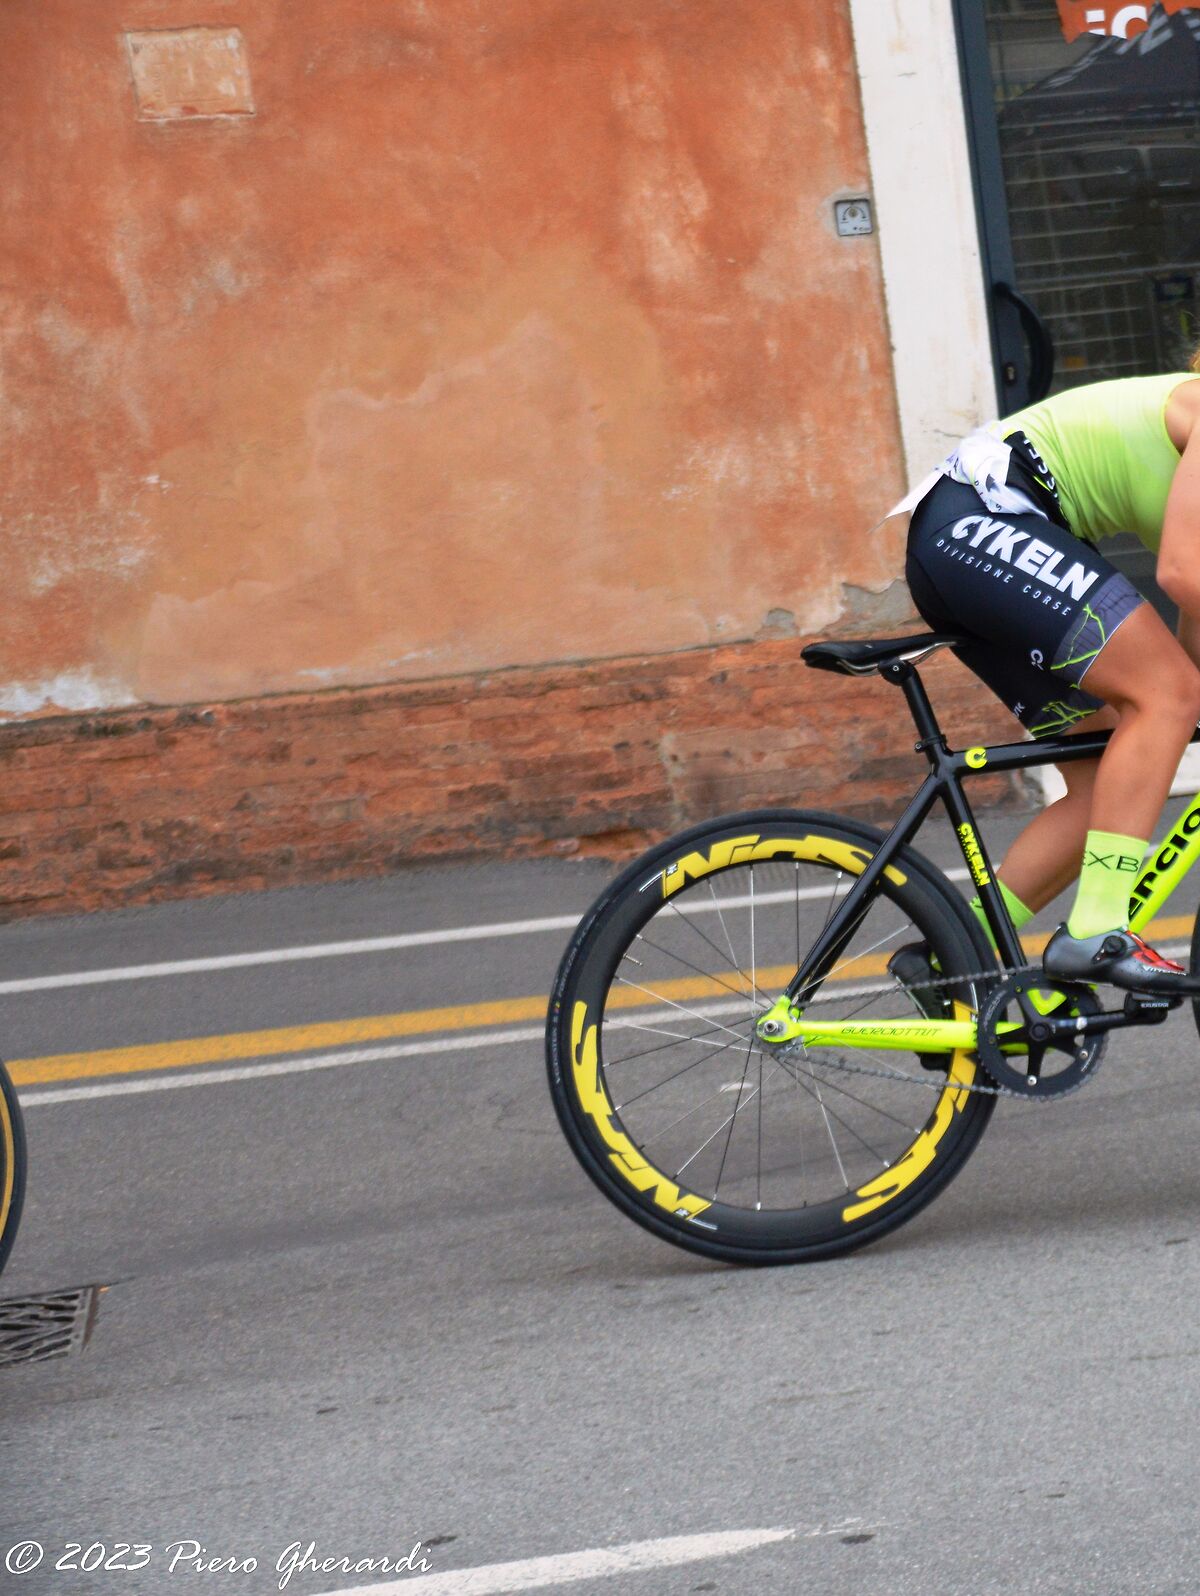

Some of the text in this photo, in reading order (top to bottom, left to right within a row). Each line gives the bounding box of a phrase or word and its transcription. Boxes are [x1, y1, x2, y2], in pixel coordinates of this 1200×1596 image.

[936, 539, 1072, 617] DIVISIONE CORSE
[952, 515, 1100, 601] CYKELN
[960, 823, 990, 885] CYKELN
[1082, 851, 1139, 872] XB
